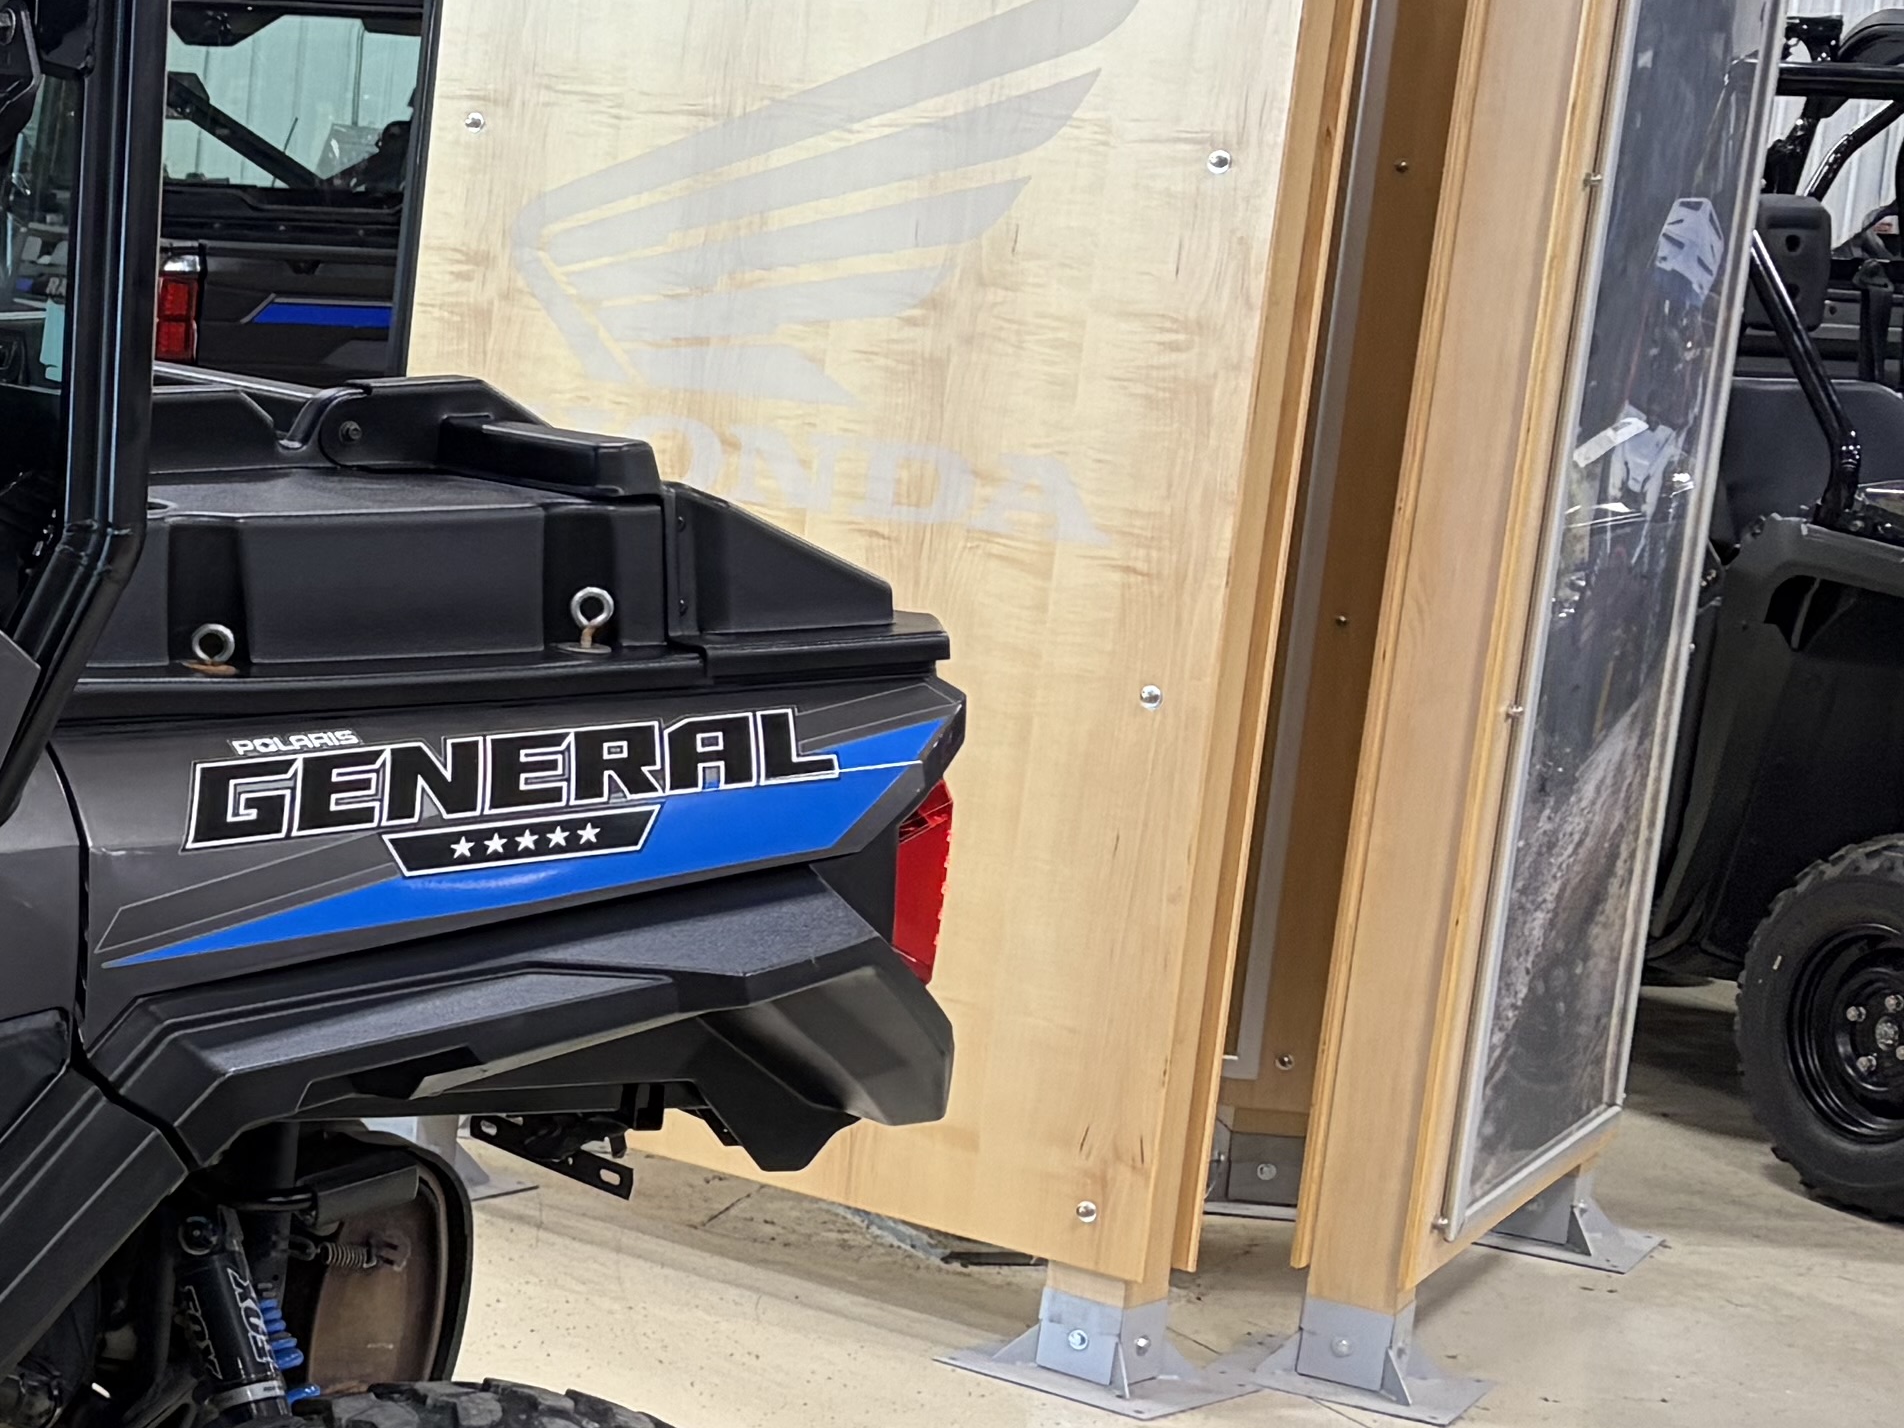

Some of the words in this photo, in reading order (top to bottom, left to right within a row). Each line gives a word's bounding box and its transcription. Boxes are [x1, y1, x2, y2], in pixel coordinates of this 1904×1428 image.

[530, 402, 1110, 550] ONDA
[184, 708, 841, 851] GENERAL
[231, 729, 360, 757] POLARIS
